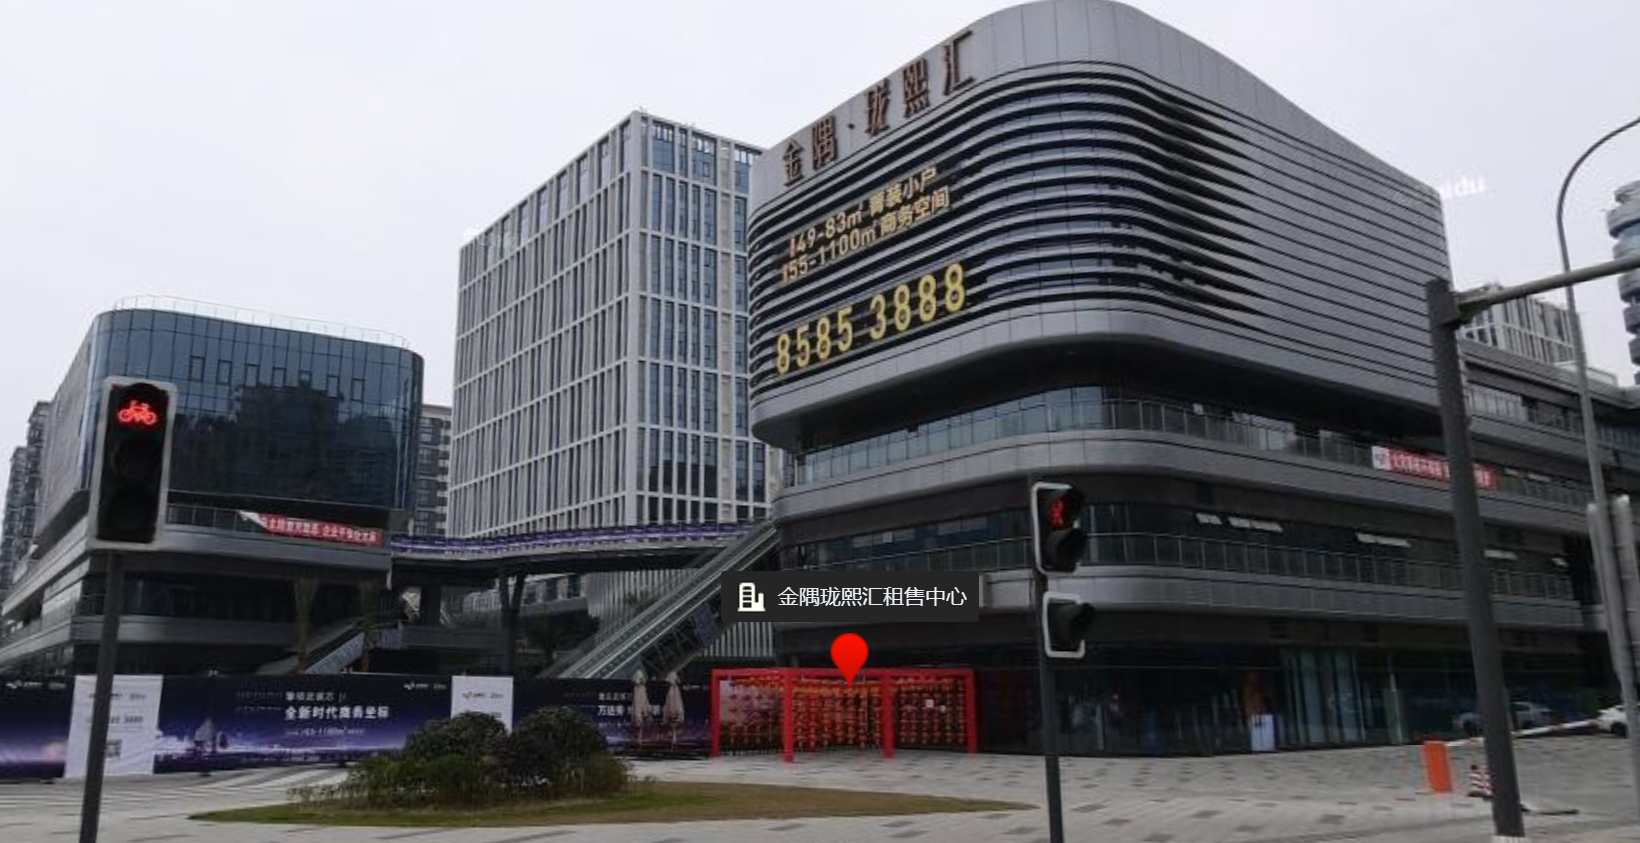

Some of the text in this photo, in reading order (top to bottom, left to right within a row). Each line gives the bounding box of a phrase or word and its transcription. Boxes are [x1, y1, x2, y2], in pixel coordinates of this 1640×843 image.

[880, 186, 949, 235] 商务空间
[776, 263, 965, 373] 8585 3888
[285, 705, 390, 720] 全新时代商务坐标
